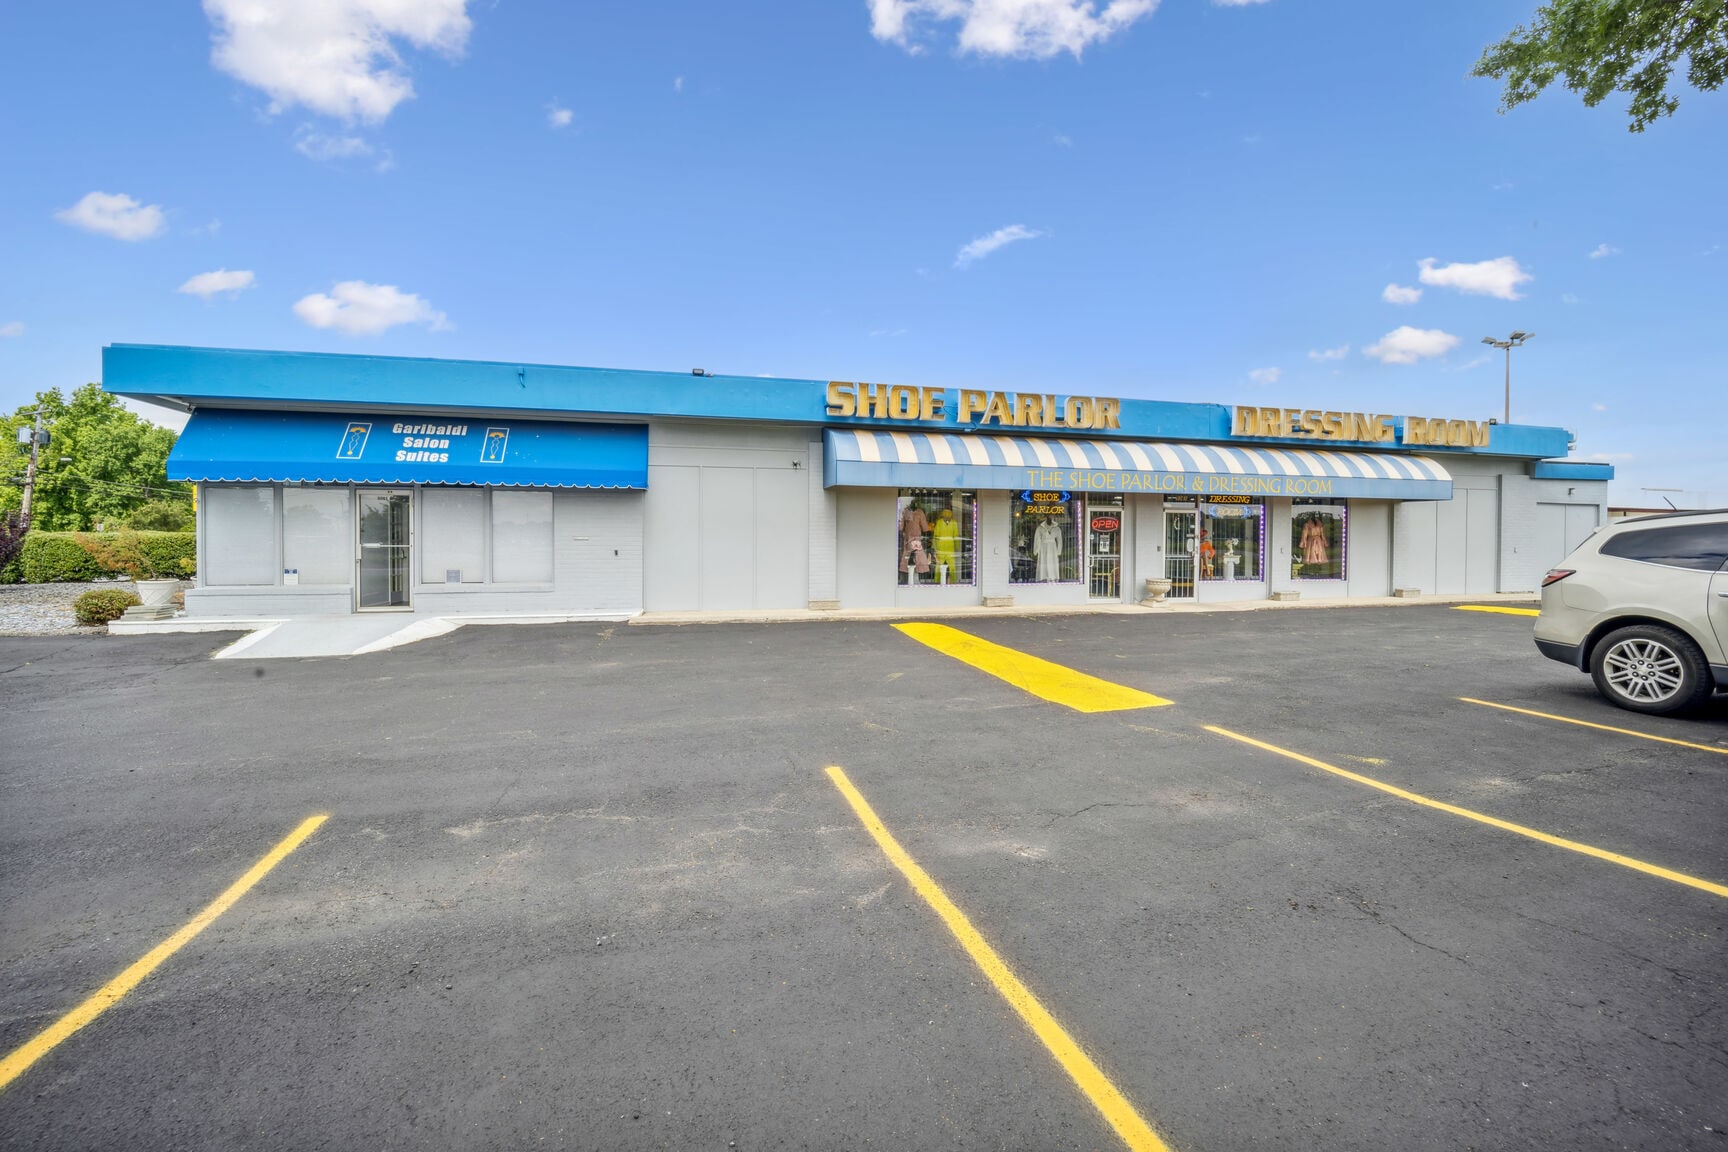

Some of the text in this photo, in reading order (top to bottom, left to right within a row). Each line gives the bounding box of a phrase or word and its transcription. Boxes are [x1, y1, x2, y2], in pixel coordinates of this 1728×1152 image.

[826, 381, 1121, 429] SHOE PARLOR
[392, 423, 468, 436] Garibaldi
[1231, 405, 1490, 447] DRESSING ROOM
[402, 436, 450, 449] Salon
[395, 450, 449, 463] Suites
[1027, 470, 1332, 494] THE SHOE PARLOR & DRESSING ROOM
[1033, 493, 1060, 502] SHOE
[1209, 495, 1251, 504] DRESSING
[1025, 505, 1065, 514] PARLOR
[1091, 520, 1119, 529] OPEN
